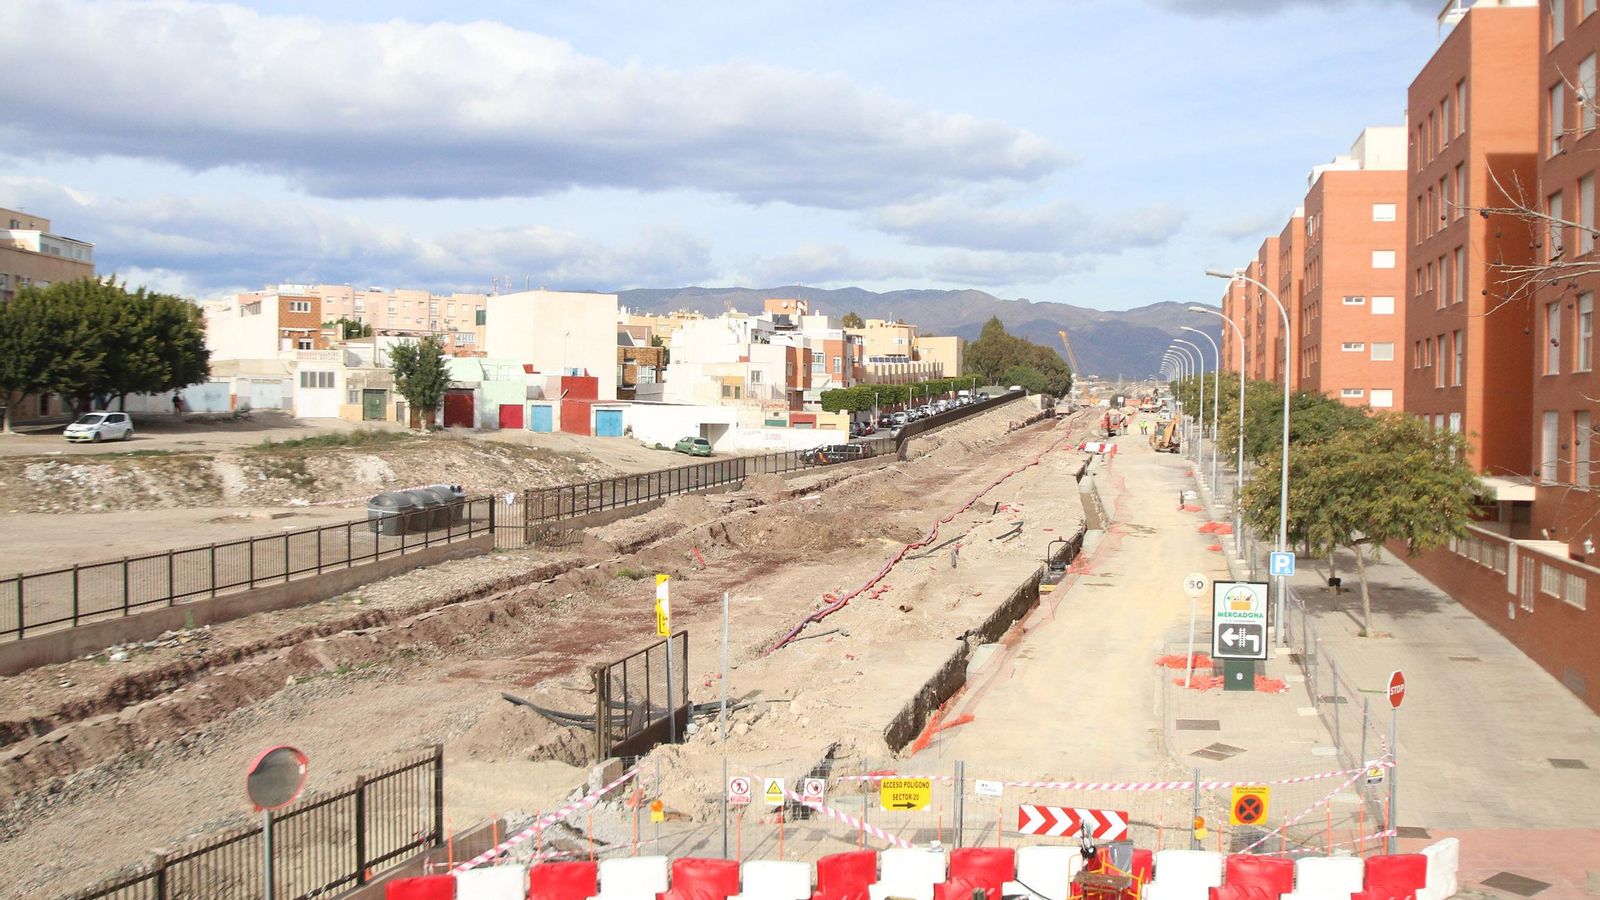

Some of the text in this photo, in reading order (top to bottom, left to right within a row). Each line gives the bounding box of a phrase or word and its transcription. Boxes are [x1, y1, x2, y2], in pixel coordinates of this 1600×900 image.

[1276, 554, 1290, 573] P
[1189, 580, 1204, 590] 50
[1217, 611, 1264, 619] MERCADONA
[1390, 683, 1405, 696] STOP
[882, 781, 903, 789] ACCESO
